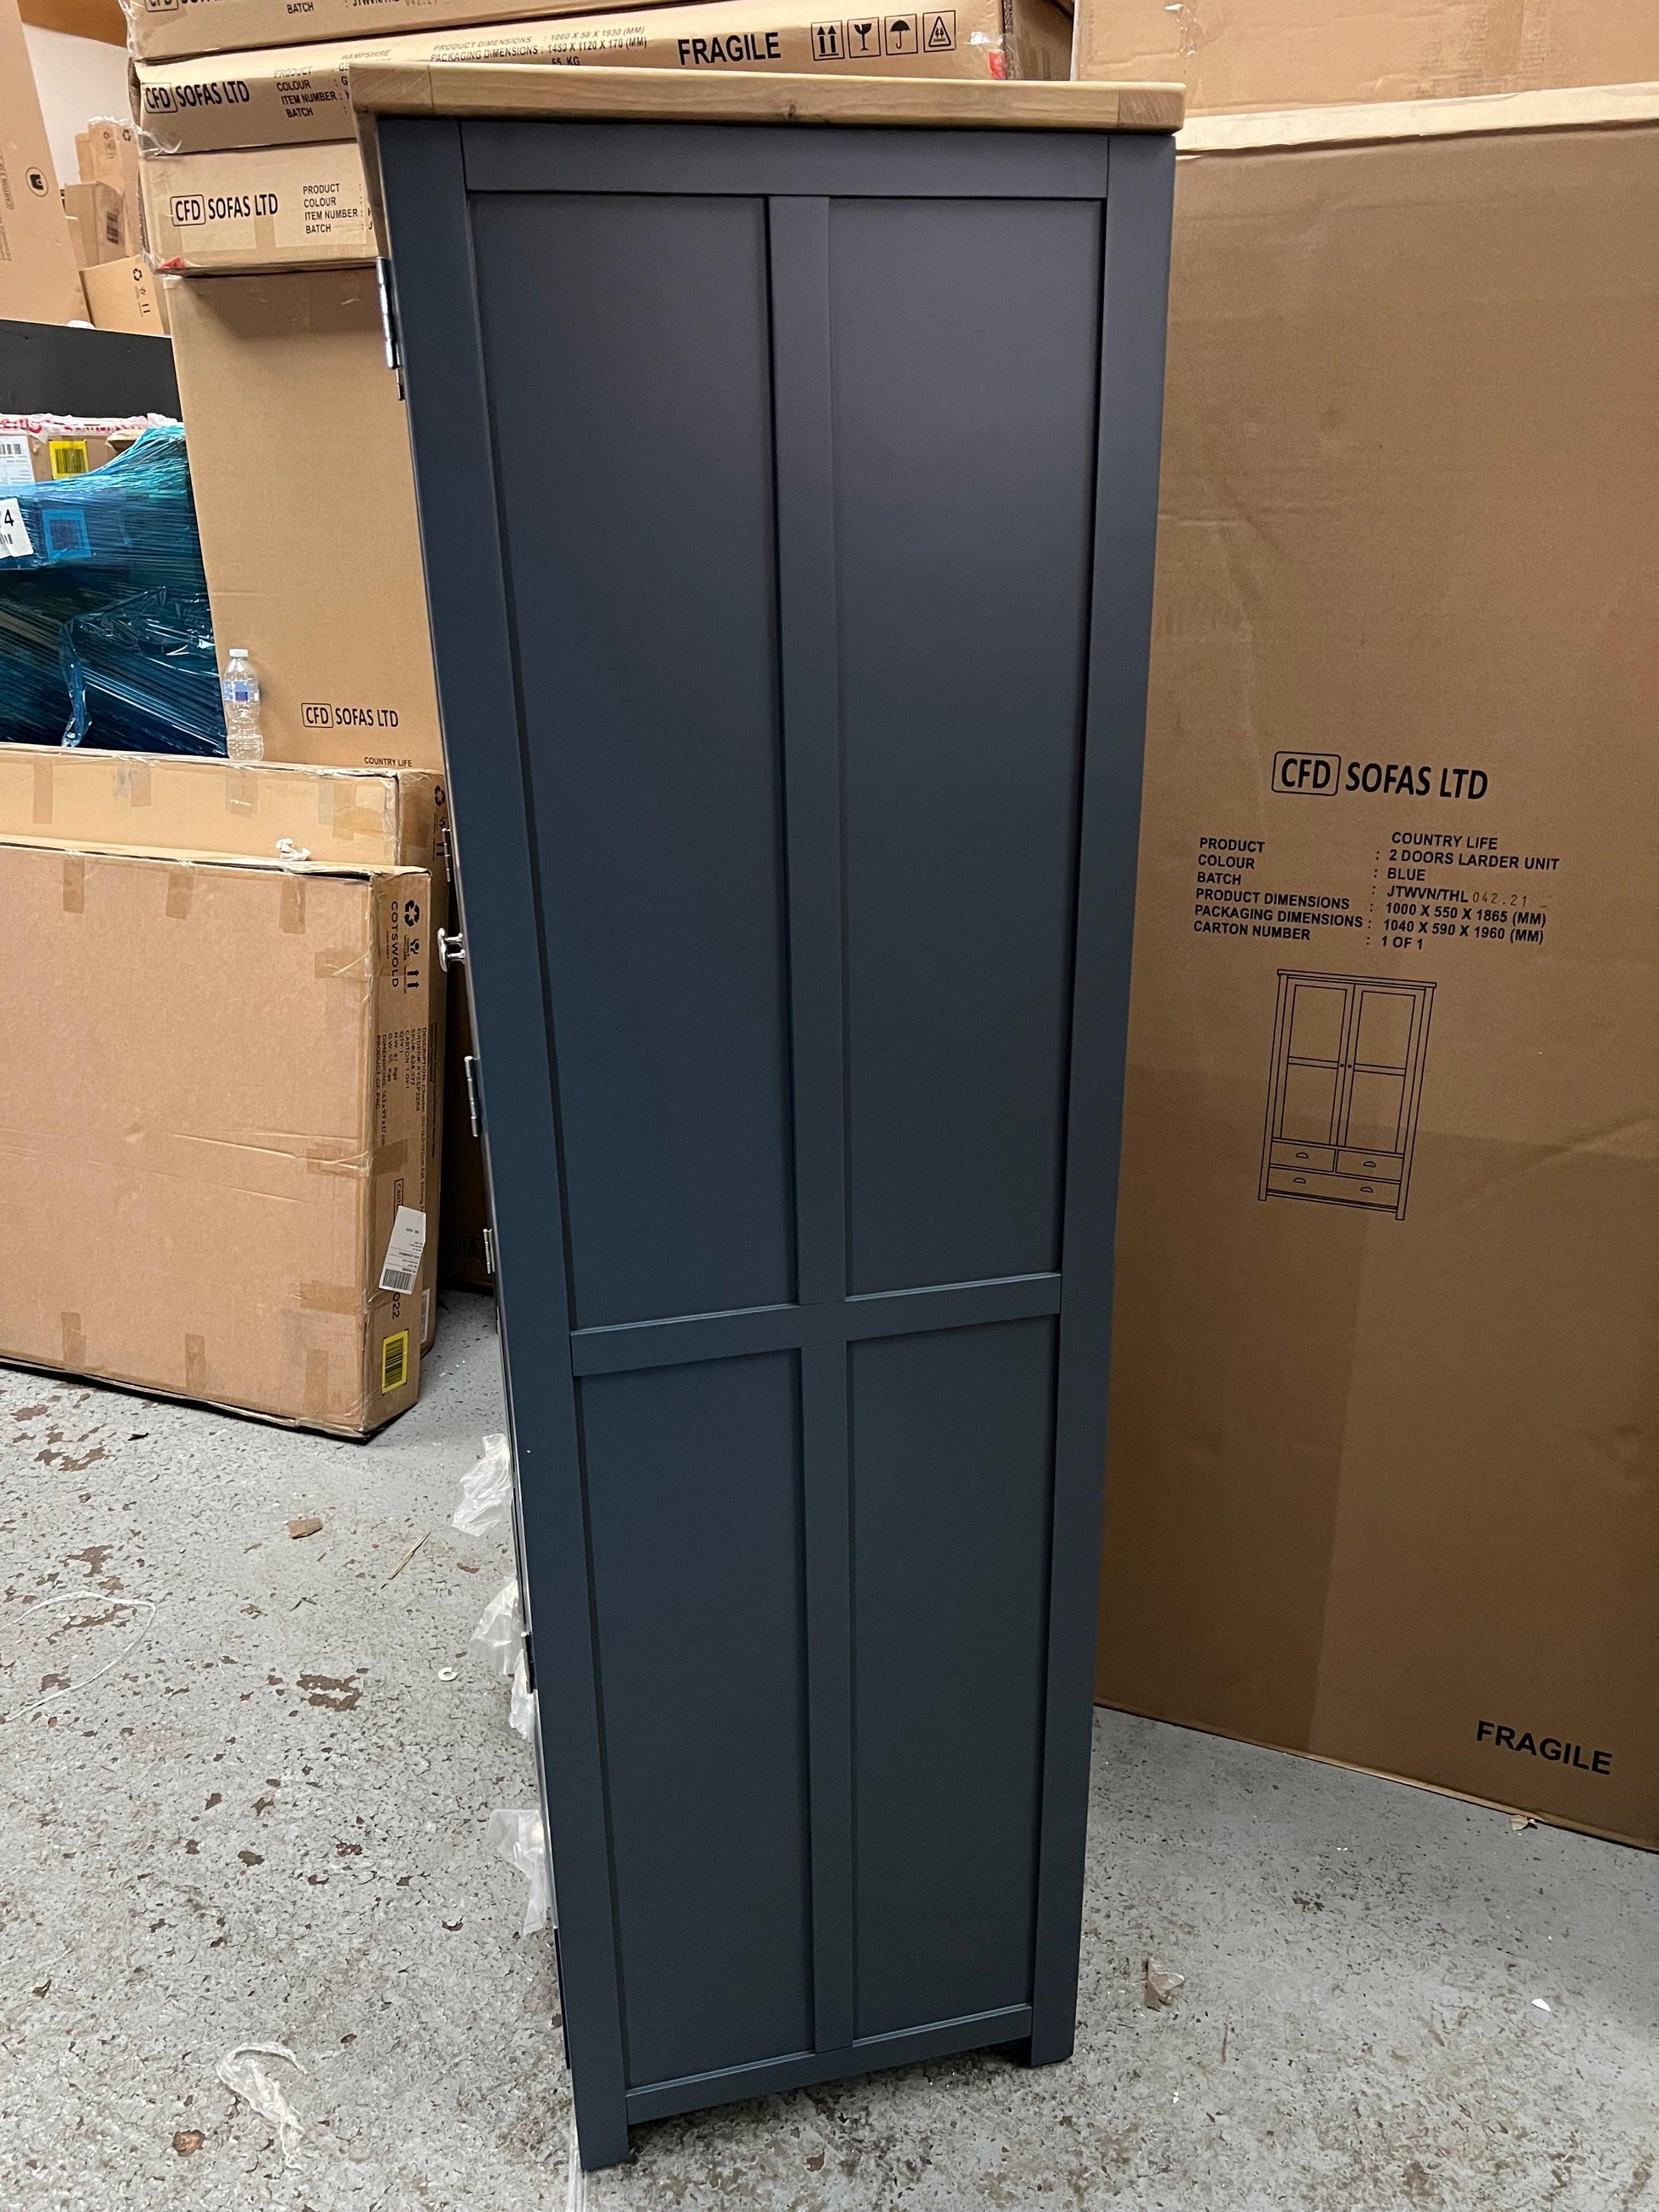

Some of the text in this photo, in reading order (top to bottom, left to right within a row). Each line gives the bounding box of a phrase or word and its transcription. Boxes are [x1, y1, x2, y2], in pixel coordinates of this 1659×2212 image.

[286, 2, 314, 14] BATCH
[431, 50, 482, 62] PACKAGING
[483, 45, 539, 59] DIMENSIONS
[569, 42, 575, 52] X
[579, 40, 597, 51] 1120
[599, 39, 606, 50] X
[609, 38, 623, 49] 170
[625, 36, 647, 50] (MM)
[433, 41, 477, 51] PRODUCT
[477, 36, 532, 48] DIMENSIONS
[622, 26, 645, 36] (MM)
[678, 32, 782, 66] FRAGILE
[341, 49, 391, 61] HAMPSHIRE
[566, 55, 581, 66] KG
[274, 66, 313, 78] PRODUCT
[145, 80, 250, 109] CFD SOFAS LTD
[276, 79, 311, 92] COLOUR
[280, 95, 301, 106] ITEM
[302, 90, 338, 103] NUMBER
[286, 107, 314, 118] BATCH
[303, 183, 340, 195] PRODUCT
[176, 193, 279, 222] CFD SOFAS LTD
[303, 196, 337, 208] COLOUR
[304, 211, 322, 221] ITEM
[324, 208, 358, 219] NUMBER
[305, 223, 332, 234] BATCH
[306, 707, 399, 728] CFD SOFAS LTD
[364, 756, 413, 767] COUNTRY LIFE
[1280, 758, 1489, 800] CFD SOFAS LTD
[1391, 831, 1498, 850] COUNTRY LIFE
[1199, 837, 1560, 871] PRODUCT 2 DOORS LARDER UNIT
[1198, 853, 1425, 881] COLOUR BLUE
[1197, 871, 1242, 886] BATCH
[1387, 885, 1469, 903] JTWVN/THL
[1195, 887, 1546, 927] PRODUCT DIMENSIONS 1000 X 550 X 1865 (MM)
[1194, 904, 1545, 945] PACKAGING DIMENSIONS 1040 X 590 X 1960 (MM)
[1194, 920, 1424, 950] CARTON NUMBER 1 OF 1
[1477, 1720, 1613, 1776] FRAGILE
